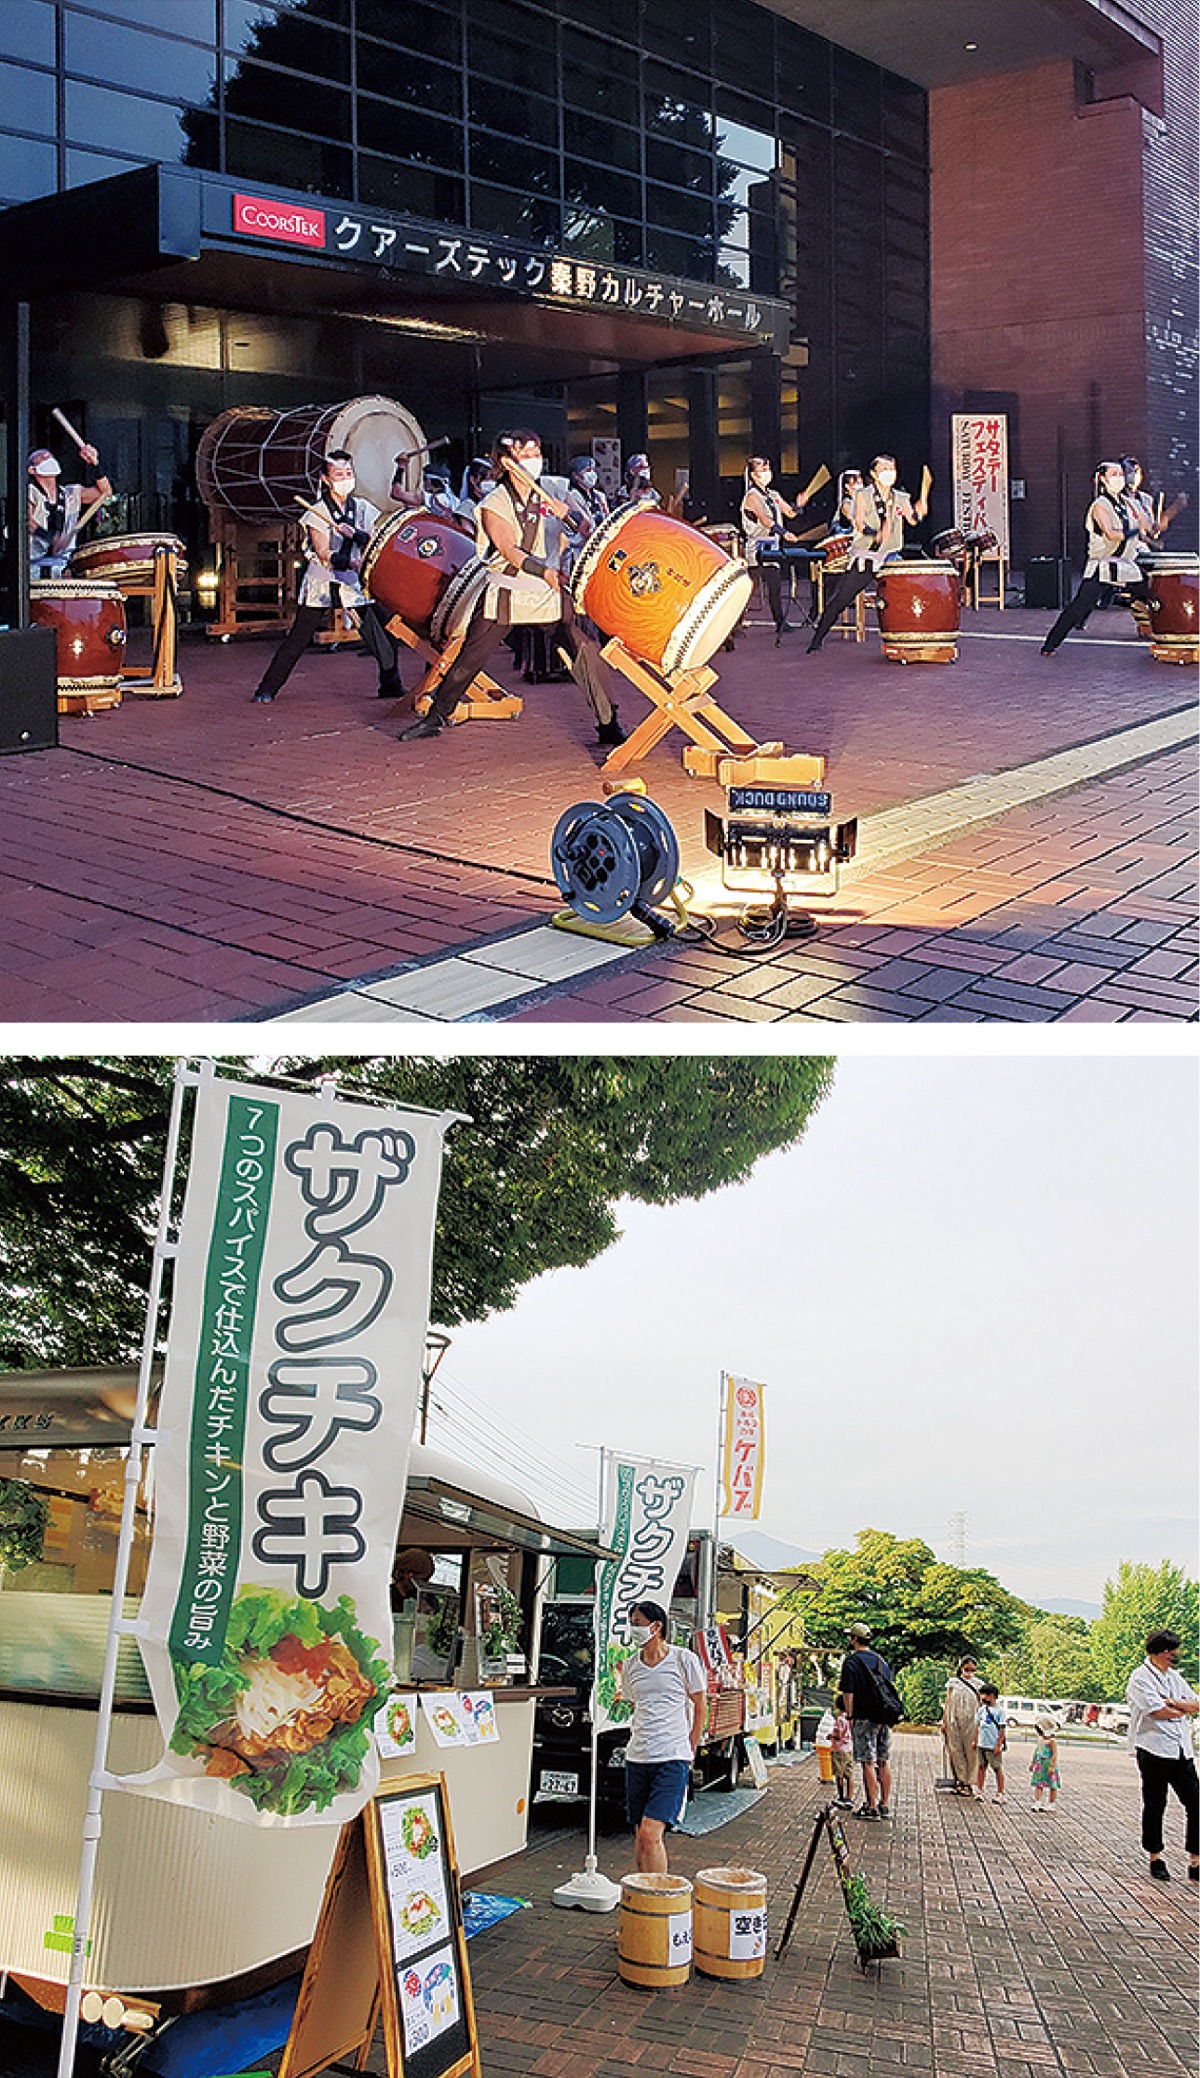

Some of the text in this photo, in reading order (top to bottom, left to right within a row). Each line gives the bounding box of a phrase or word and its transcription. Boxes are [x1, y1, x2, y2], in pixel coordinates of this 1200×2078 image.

[971, 421, 988, 531] フェスティバ
[986, 420, 1000, 492] サタデー
[184, 1106, 265, 1649] 7つのスパイスで仕込んだチキンと野菜の旨み
[253, 1123, 416, 1599] ザクチキ
[732, 1438, 756, 1512] ケバブ
[735, 1914, 768, 1937] 空き
